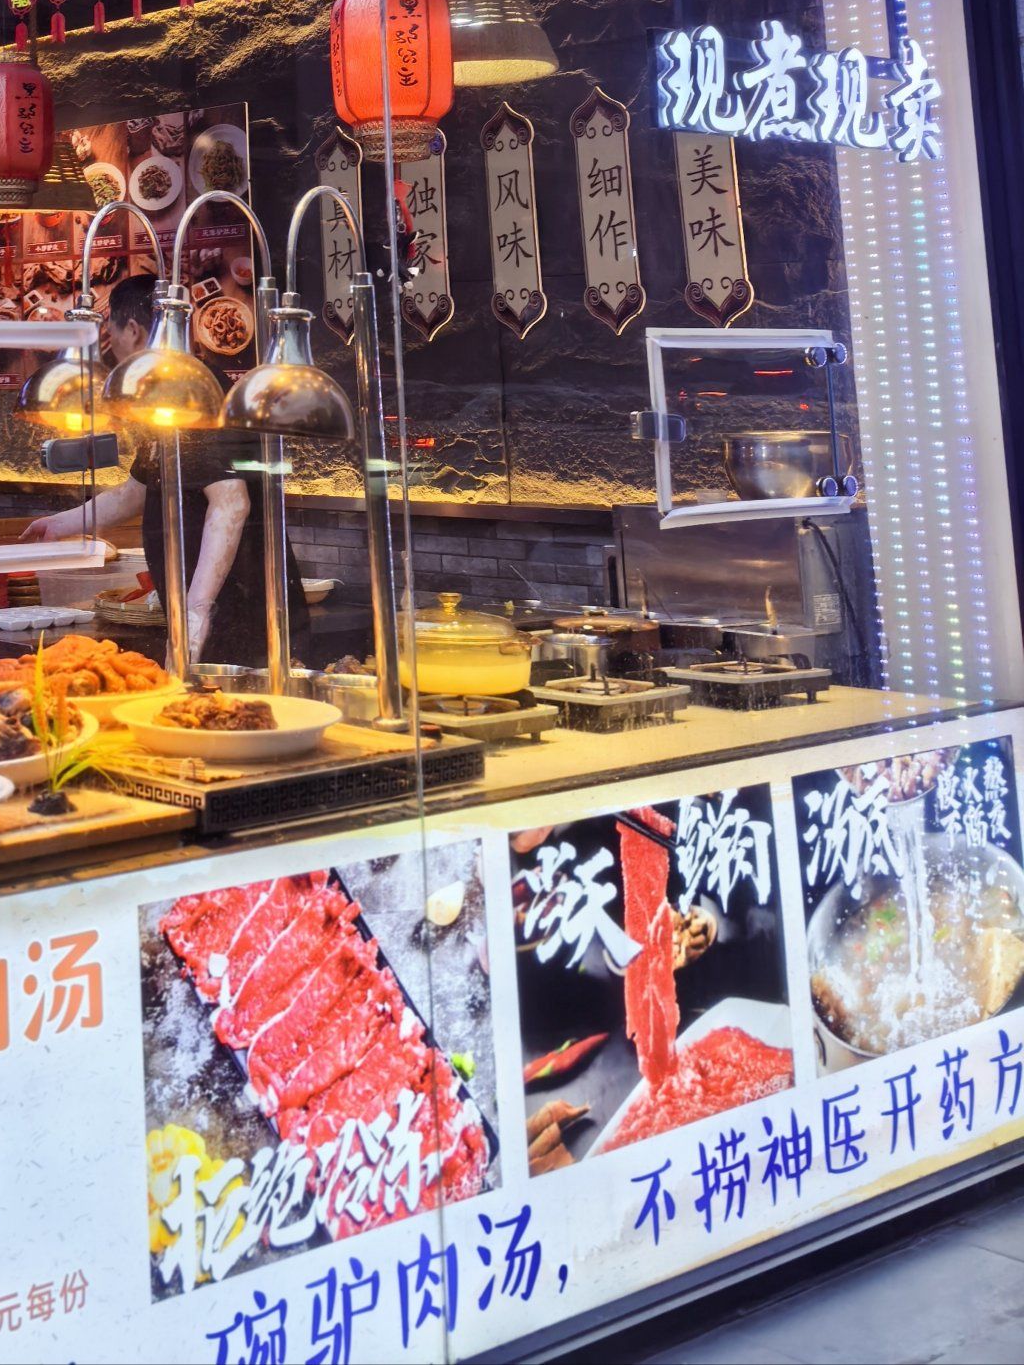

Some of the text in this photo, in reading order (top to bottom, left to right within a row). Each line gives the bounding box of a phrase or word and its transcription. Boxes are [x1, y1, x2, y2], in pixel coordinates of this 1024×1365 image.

[658, 20, 942, 163] 现煮现卖
[406, 176, 443, 278] 独家
[494, 168, 534, 269] 风味
[587, 157, 628, 262] 细作
[686, 143, 736, 259] 美味
[802, 762, 906, 901] 汤底
[158, 1087, 444, 1290] 拒绝冷冻
